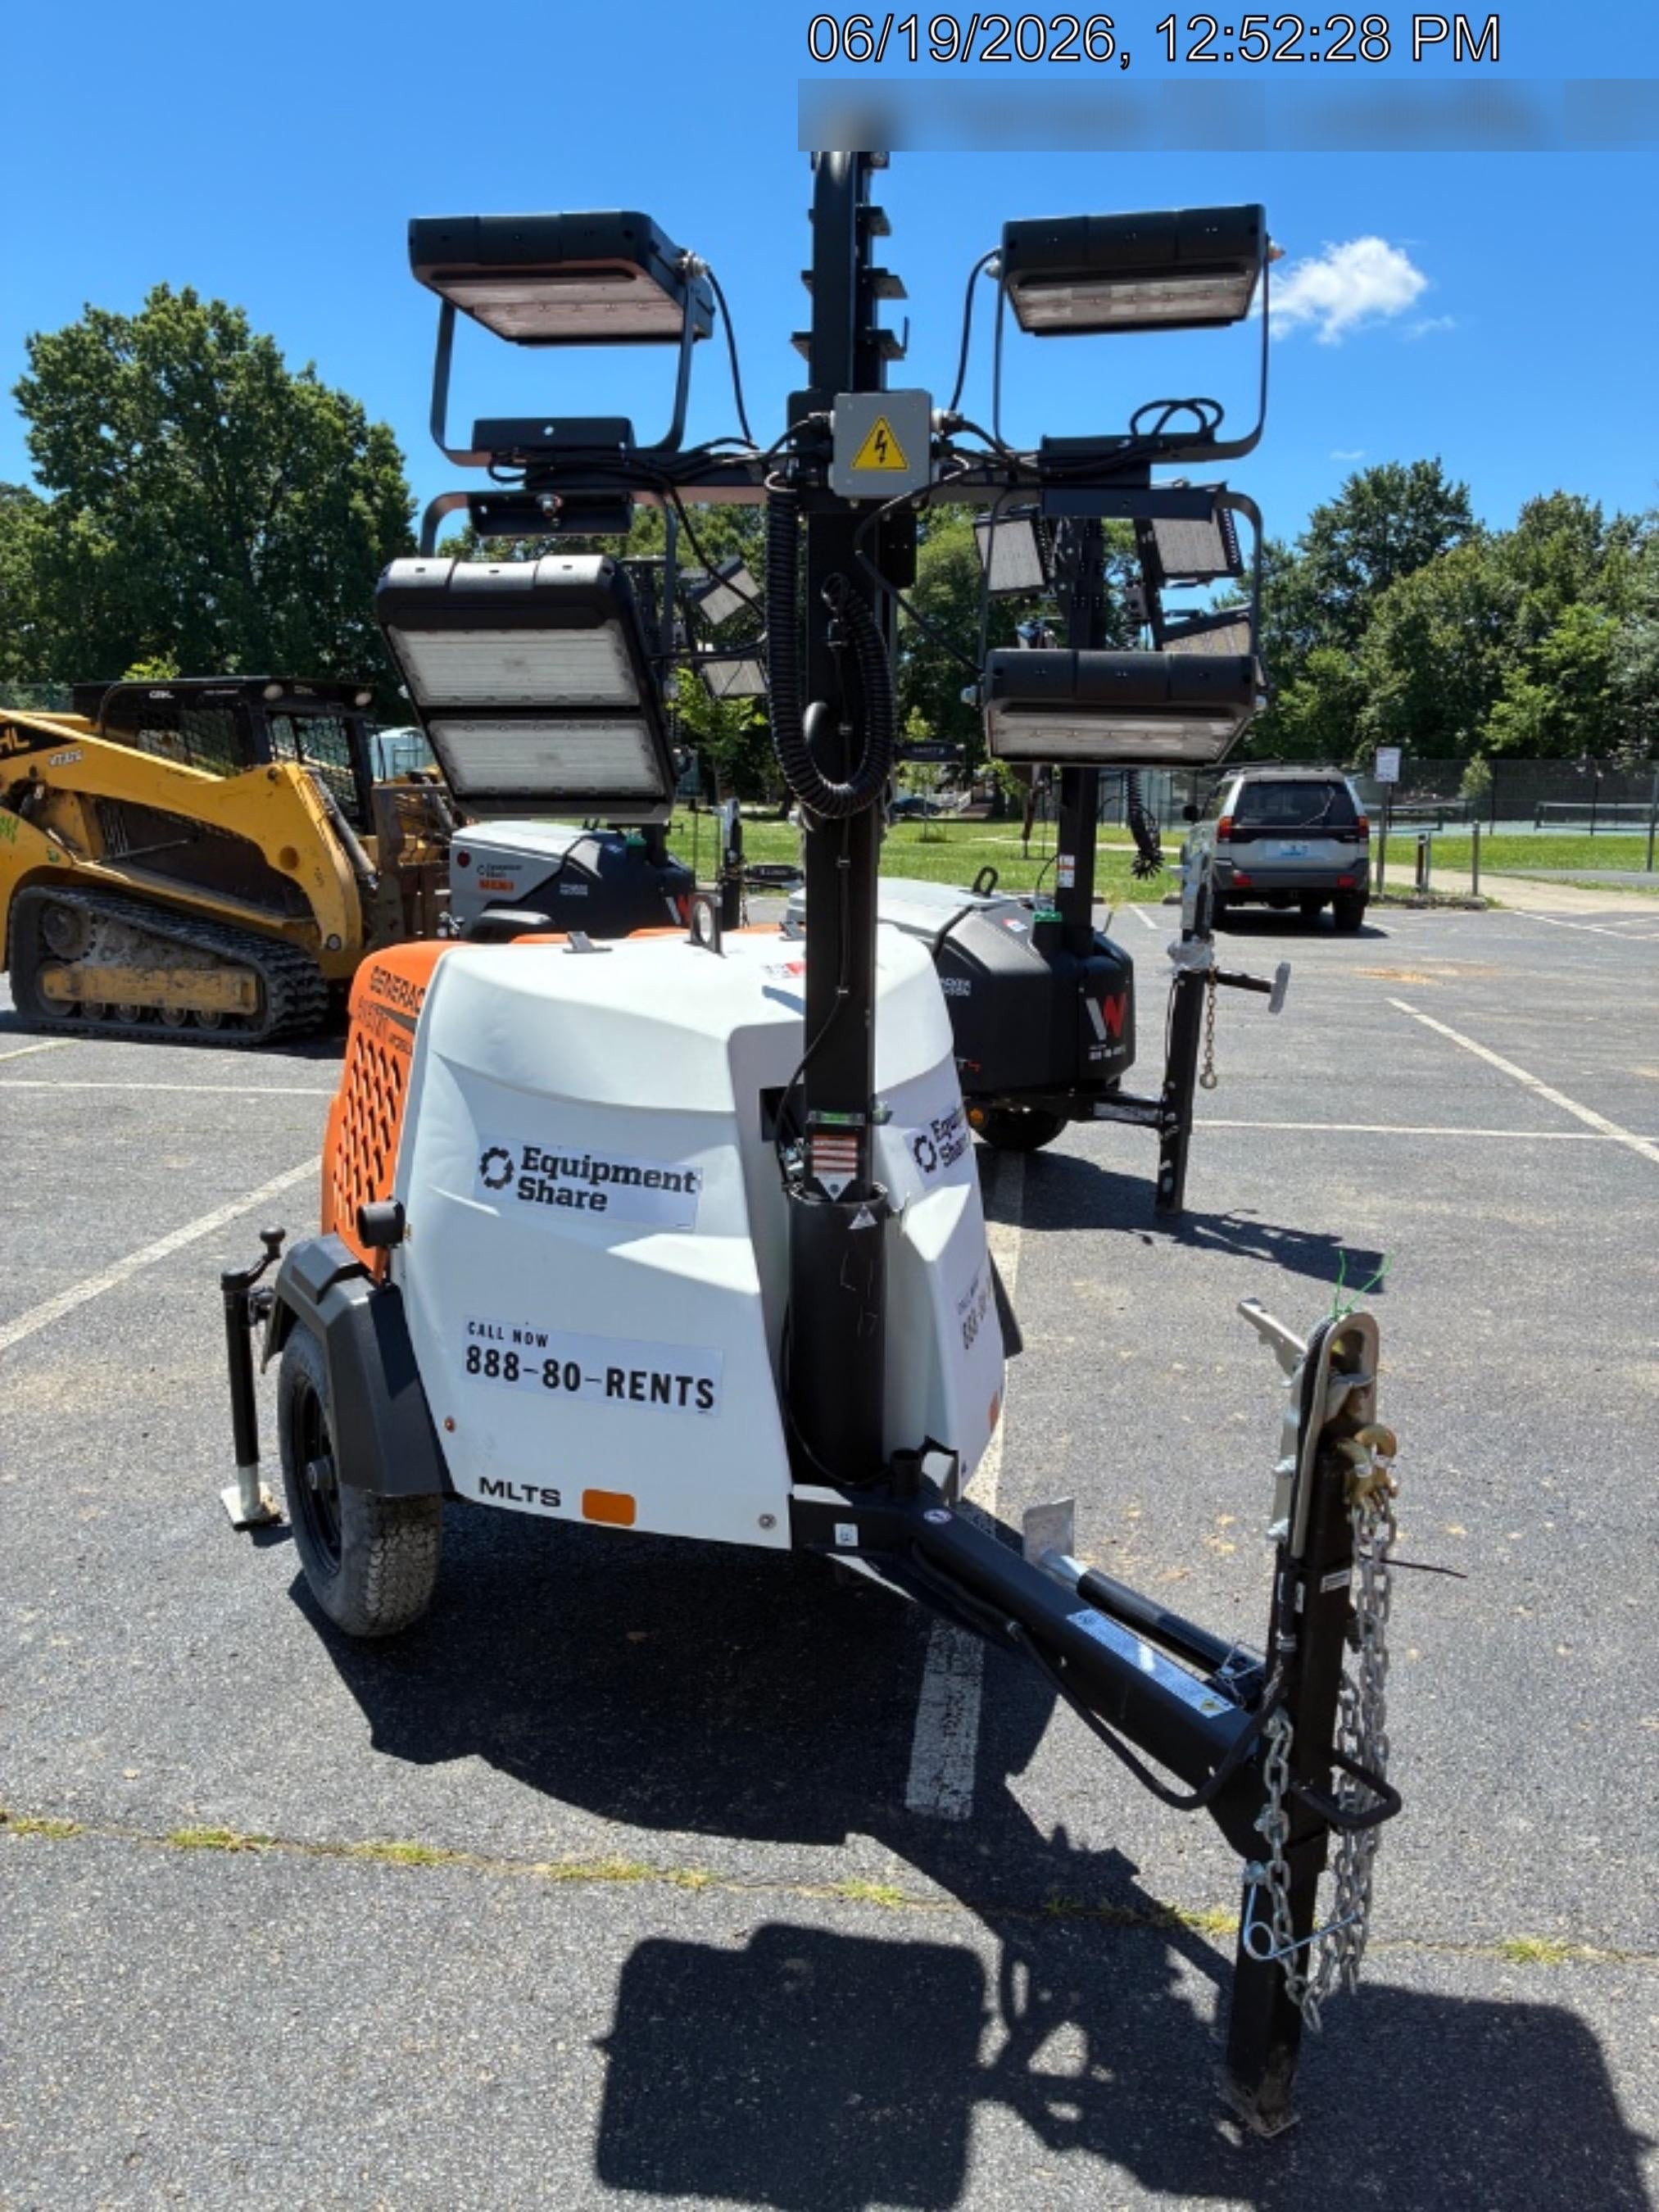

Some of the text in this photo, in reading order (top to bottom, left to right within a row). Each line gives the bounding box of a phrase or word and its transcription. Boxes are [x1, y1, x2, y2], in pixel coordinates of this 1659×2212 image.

[520, 1145, 696, 1194] Equipment
[517, 1175, 608, 1212] Share
[468, 1321, 549, 1348] CALL NOW
[466, 1344, 714, 1409] 888-80-RENTS
[478, 1476, 561, 1507] MLTS
